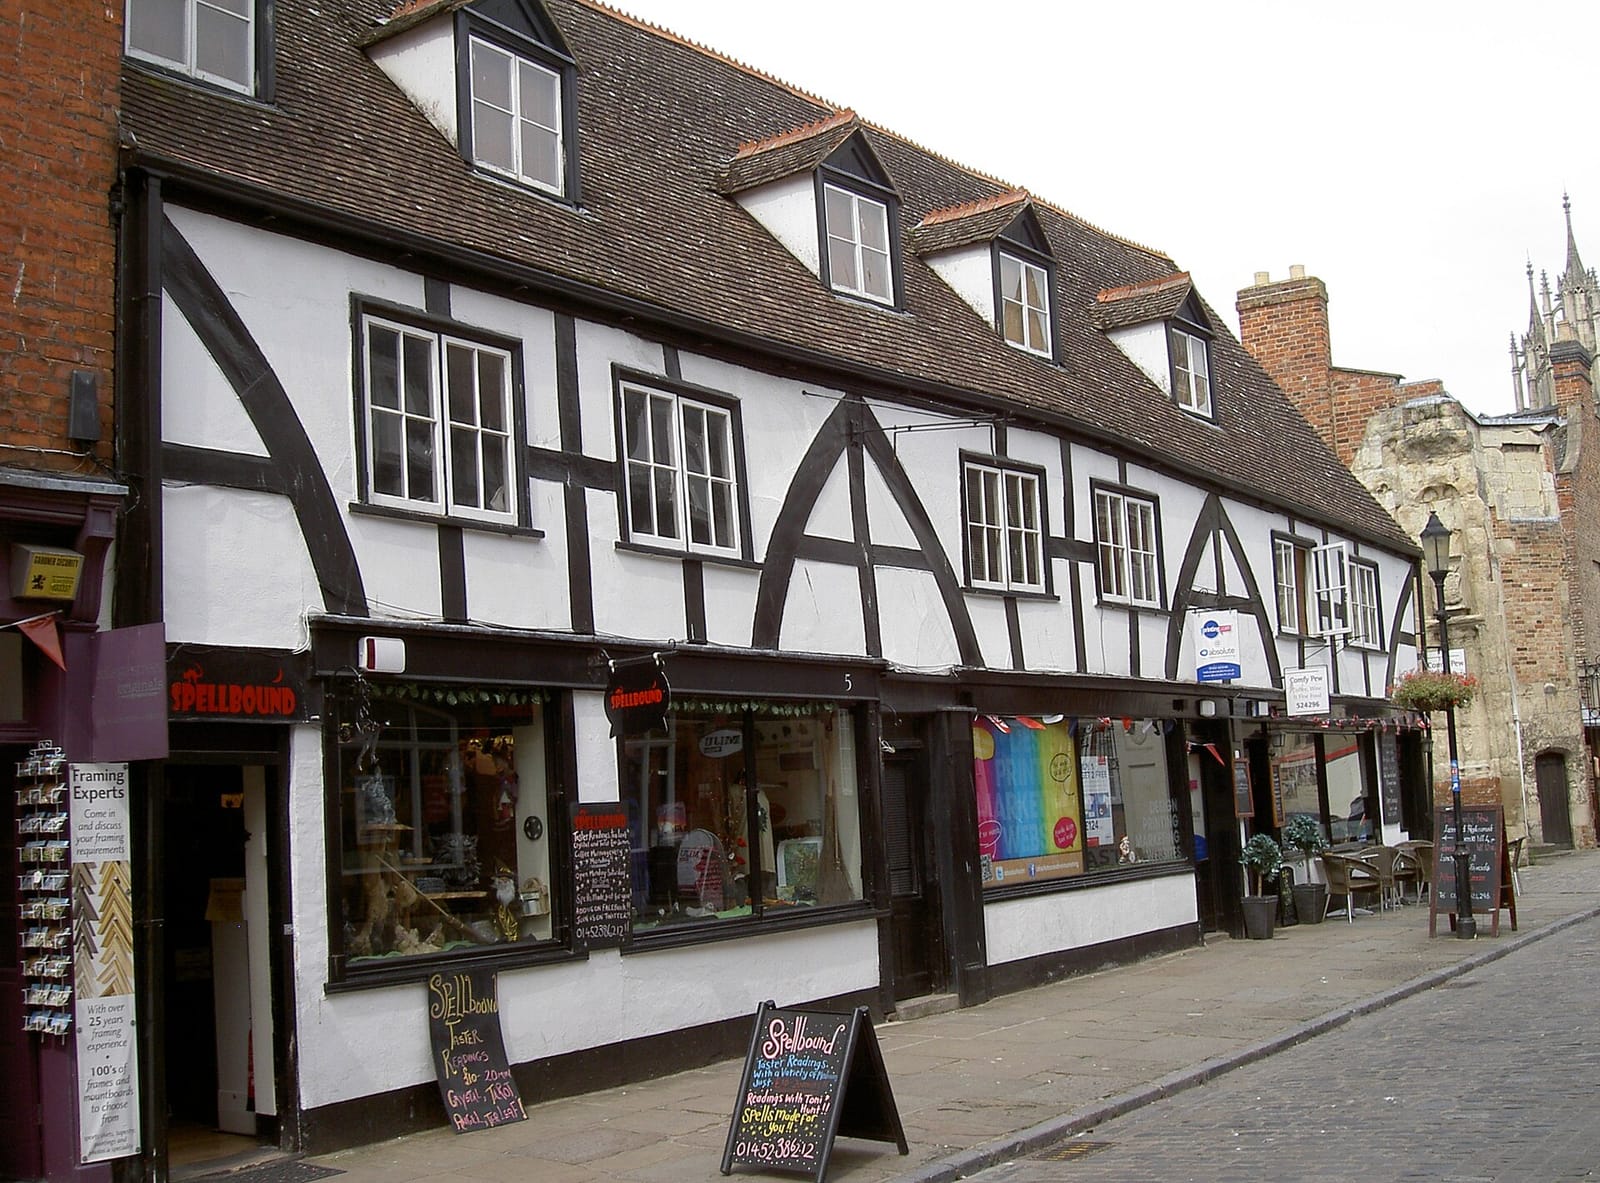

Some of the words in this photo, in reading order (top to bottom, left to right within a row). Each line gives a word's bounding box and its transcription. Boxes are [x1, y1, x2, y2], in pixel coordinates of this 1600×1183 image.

[844, 673, 852, 692] 5
[1289, 676, 1309, 684] Comfy
[170, 681, 296, 715] SPELLBOUND
[610, 688, 662, 710] SPELLBOUND
[73, 768, 125, 785] Framing
[73, 786, 125, 803] Experts
[84, 809, 107, 818] Come
[108, 808, 116, 818] in
[78, 821, 94, 831] and
[95, 821, 122, 831] discuss
[75, 836, 93, 846] your
[94, 832, 125, 845] framing
[76, 845, 125, 857] requirements
[575, 871, 589, 881] Open
[88, 1003, 106, 1014] With
[108, 1003, 125, 1013] over
[89, 1016, 101, 1026] 25
[103, 1016, 124, 1028] years
[91, 1027, 122, 1041] framing
[762, 1016, 846, 1059] Spellbound
[87, 1040, 128, 1053] experience
[91, 1065, 117, 1076] 100's
[118, 1062, 129, 1076] of
[757, 1059, 784, 1070] Taster
[753, 1069, 773, 1079] With
[774, 1070, 780, 1078] a
[85, 1079, 113, 1093] frames
[115, 1075, 131, 1086] and
[83, 1086, 134, 1102] mountboards
[746, 1088, 784, 1107] Readings
[804, 1094, 823, 1105] Toni
[91, 1104, 100, 1113] to
[101, 1101, 129, 1113] choose
[741, 1103, 775, 1124] Spells
[100, 1113, 120, 1127] from
